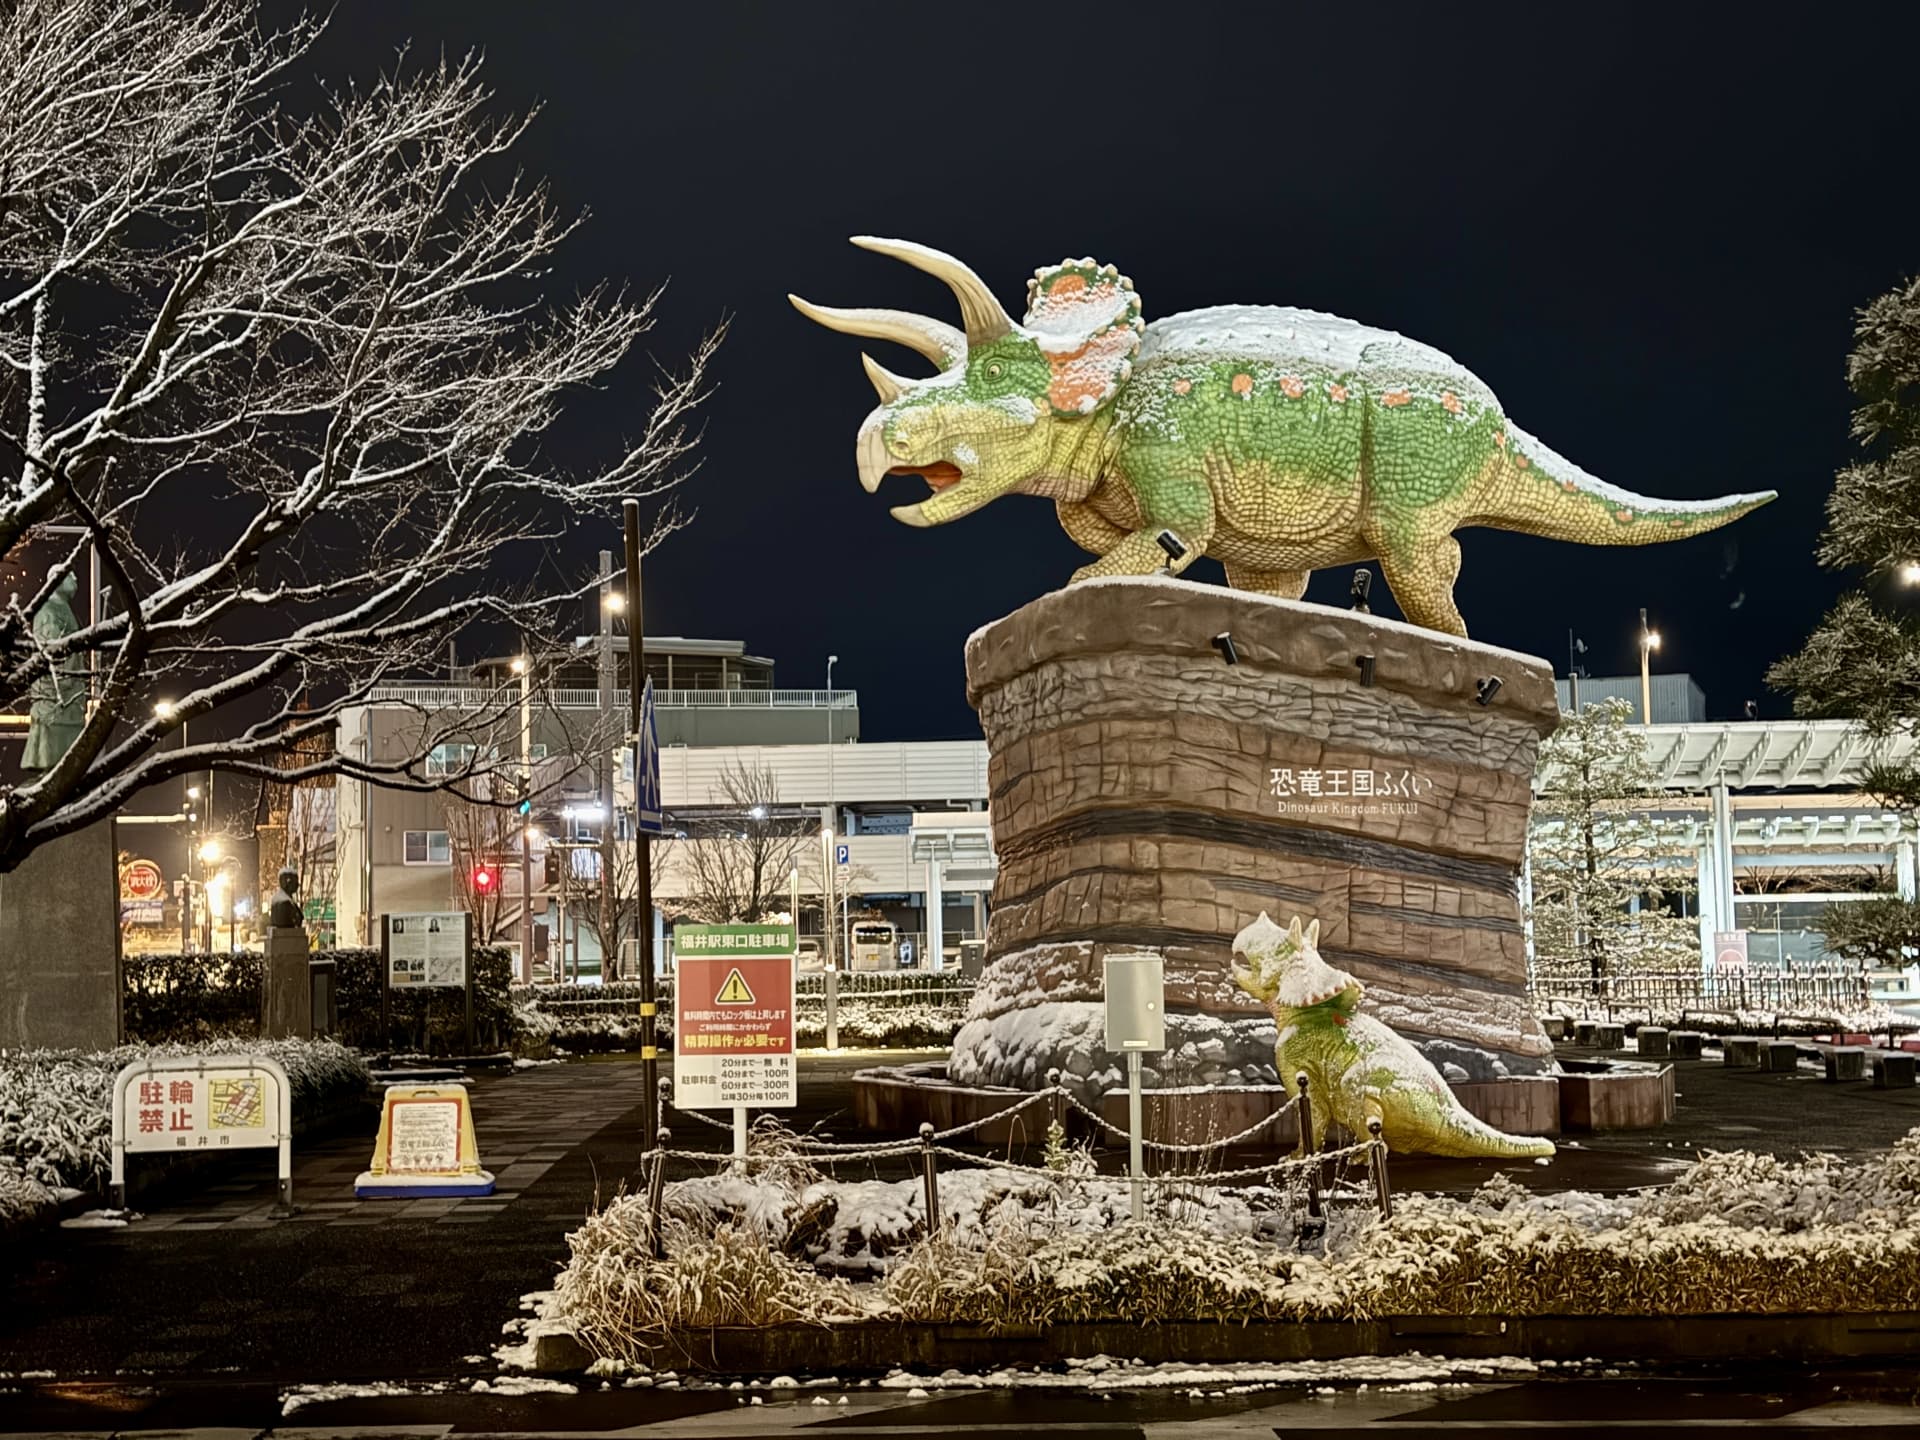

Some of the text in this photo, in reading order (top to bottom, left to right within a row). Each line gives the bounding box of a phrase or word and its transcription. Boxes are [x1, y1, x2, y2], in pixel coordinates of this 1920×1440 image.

[1270, 768, 1432, 798] 恐竜王国ふくい
[1278, 801, 1418, 817] Dinosaur Kingdom FUKUI
[839, 847, 847, 862] P
[681, 934, 790, 949] 福井駅東口駐車場
[681, 1075, 717, 1085] 駐車料金
[139, 1080, 194, 1105] 駐輪
[139, 1108, 194, 1133] 禁止
[176, 1135, 230, 1147] 福井市
